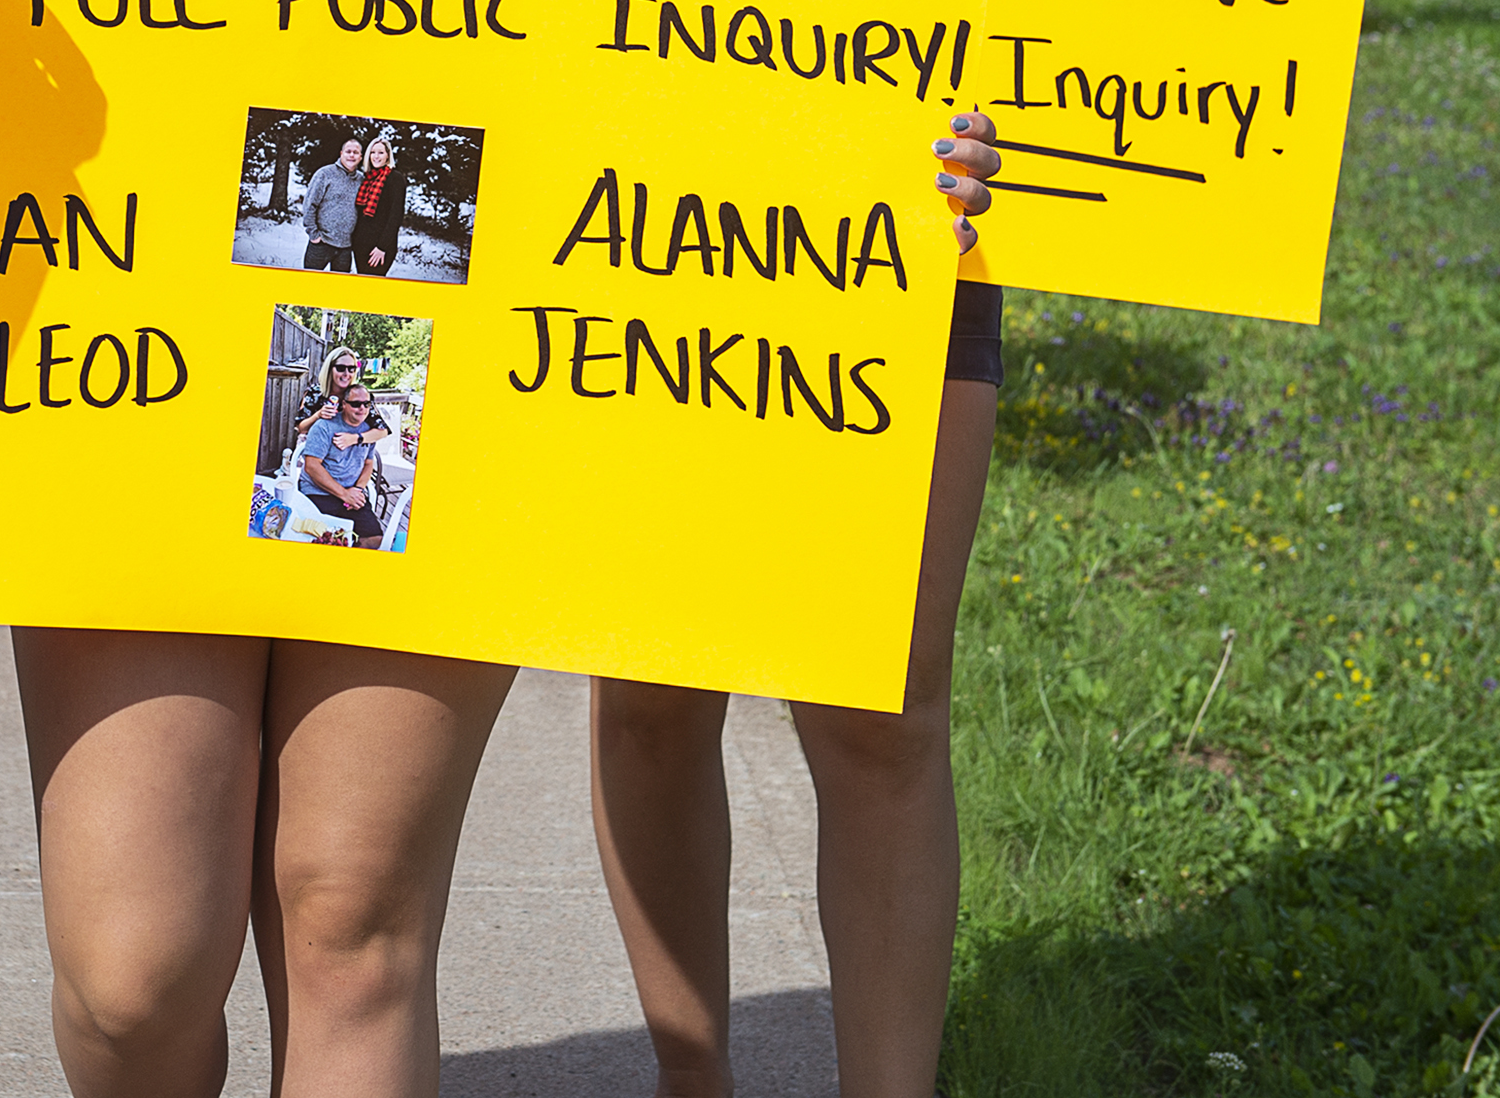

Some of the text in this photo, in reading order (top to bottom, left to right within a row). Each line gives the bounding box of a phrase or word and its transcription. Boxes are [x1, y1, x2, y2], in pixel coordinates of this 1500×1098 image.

[987, 34, 1299, 159] Inquiry!
[551, 167, 909, 293] ALANNA
[508, 306, 892, 436] JENKINS
